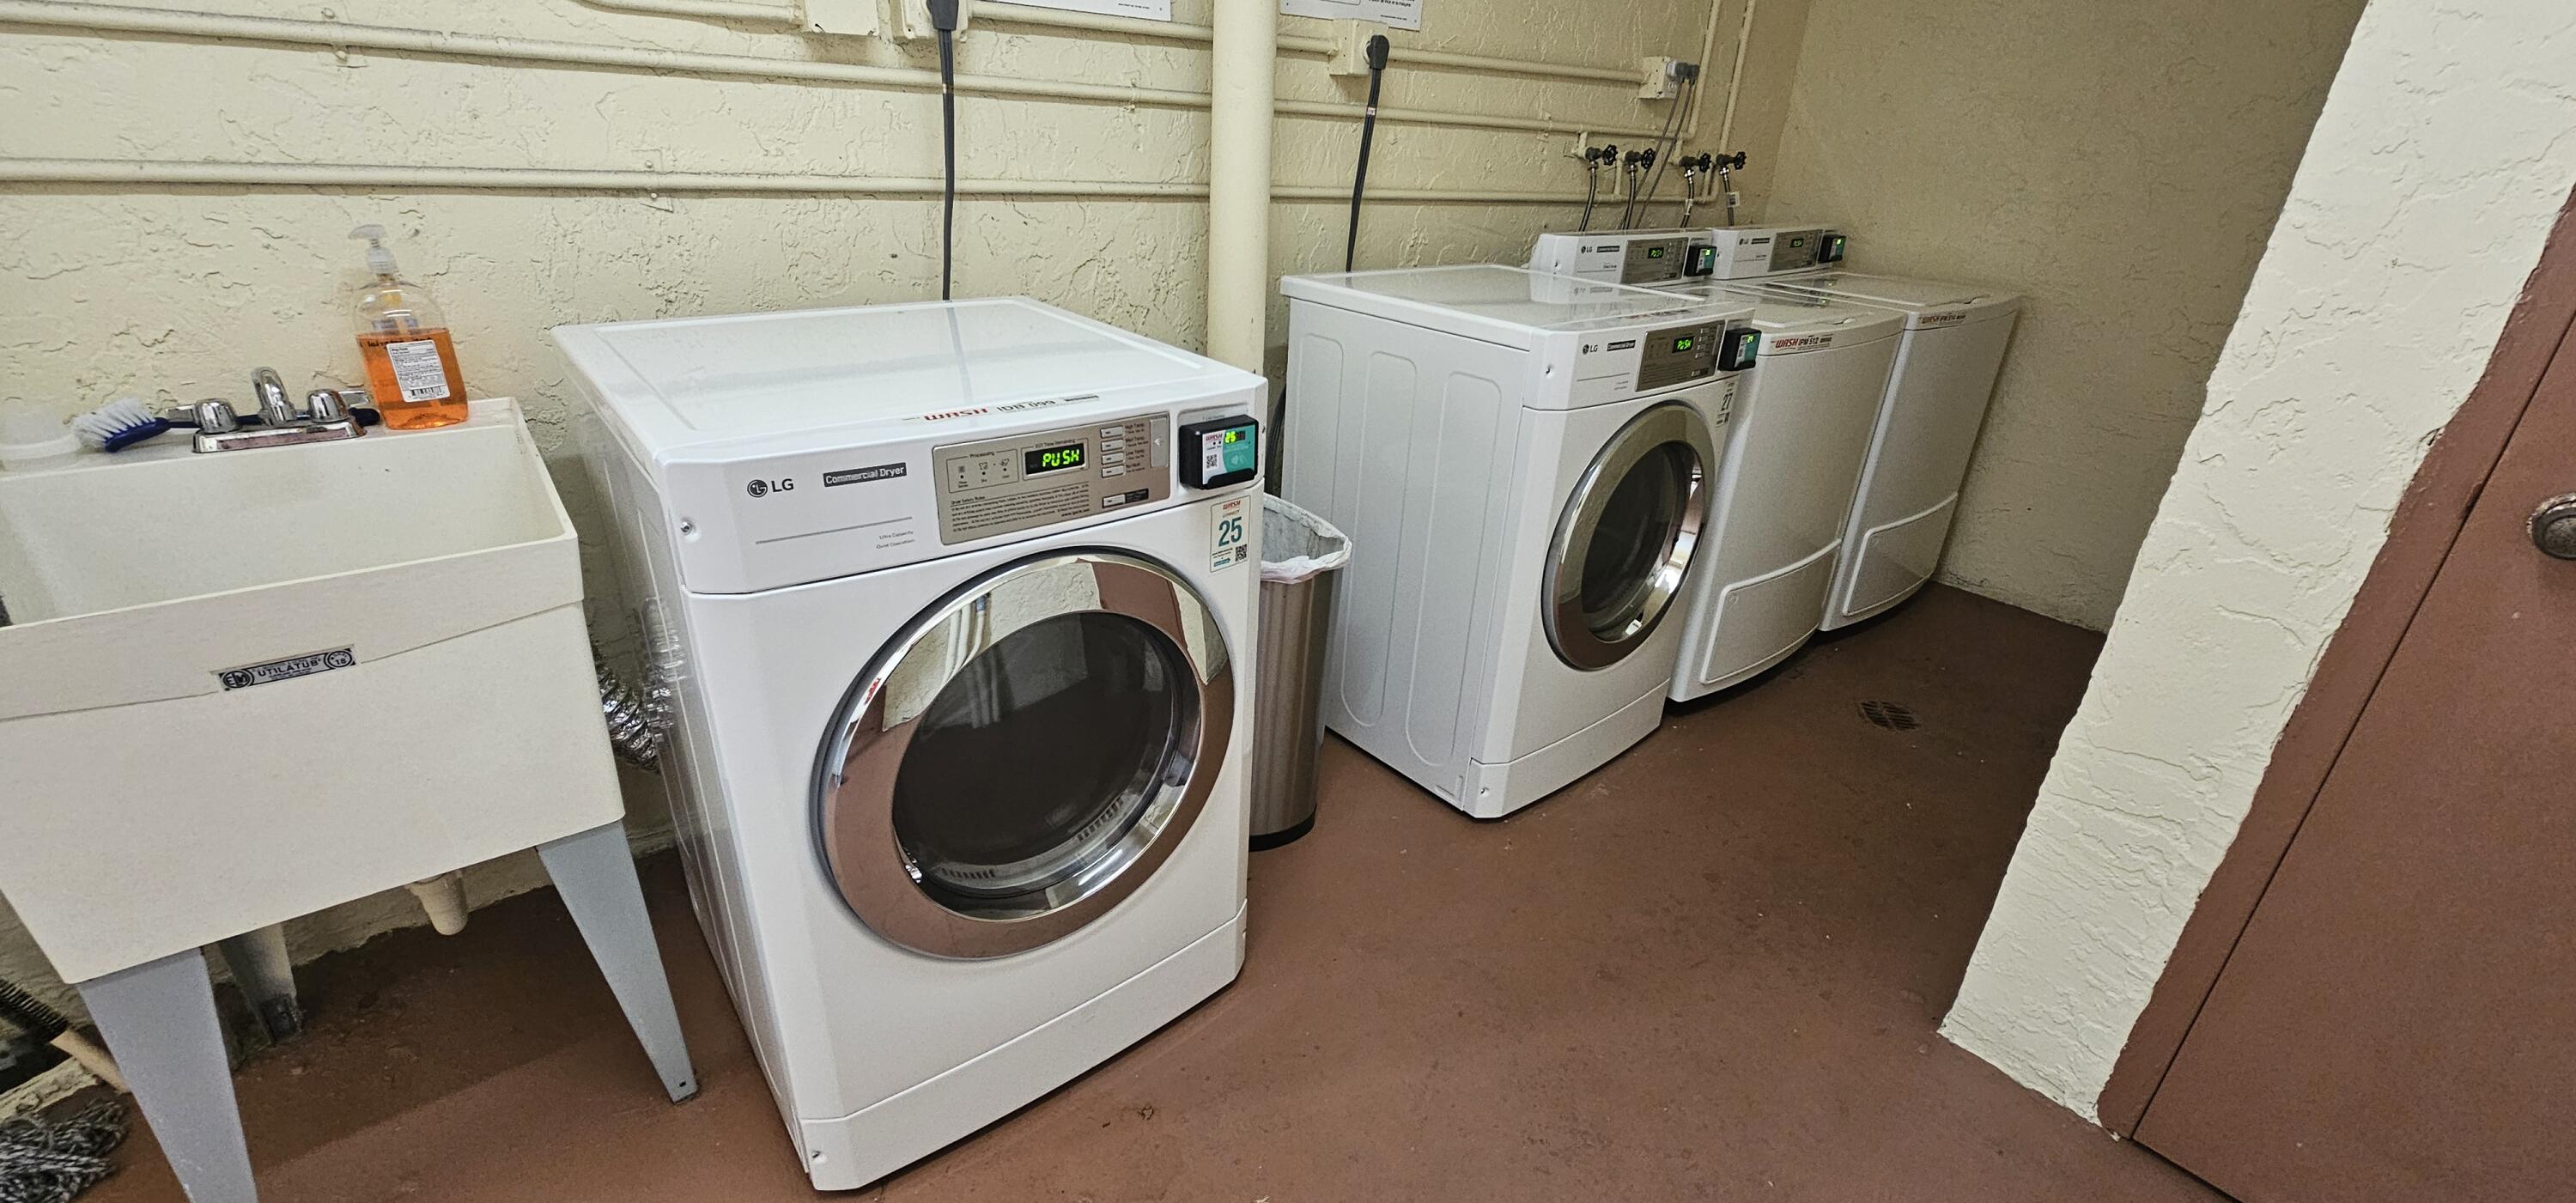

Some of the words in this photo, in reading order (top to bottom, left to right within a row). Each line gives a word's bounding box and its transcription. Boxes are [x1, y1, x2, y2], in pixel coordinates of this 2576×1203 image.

[1775, 337, 1799, 348] WASH
[1722, 392, 1733, 411] 27
[924, 407, 988, 421] WASH
[1042, 449, 1080, 467] PUSH
[825, 470, 878, 484] Commercial
[879, 465, 905, 477] Dryer
[771, 478, 794, 493] LG
[1218, 516, 1242, 547] 25
[258, 659, 319, 677] UTILATUB
